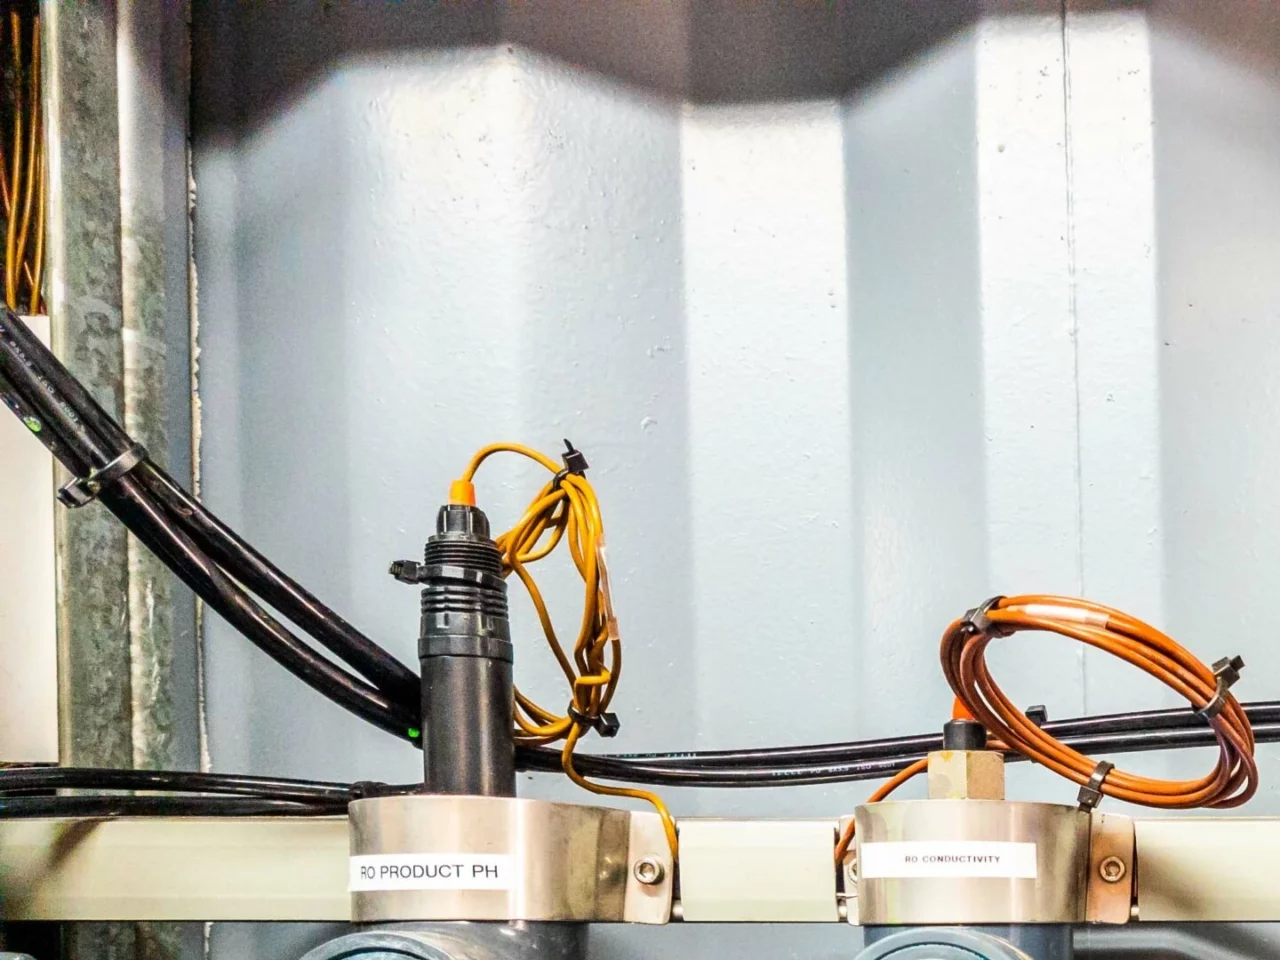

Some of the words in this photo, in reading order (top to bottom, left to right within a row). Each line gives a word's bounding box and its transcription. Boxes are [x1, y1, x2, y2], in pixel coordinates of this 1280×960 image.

[904, 855, 919, 864] RO
[922, 855, 1001, 864] CONDUCTIVITY
[360, 866, 376, 880] RO
[380, 864, 464, 879] PRODUCT
[472, 864, 499, 878] PH
